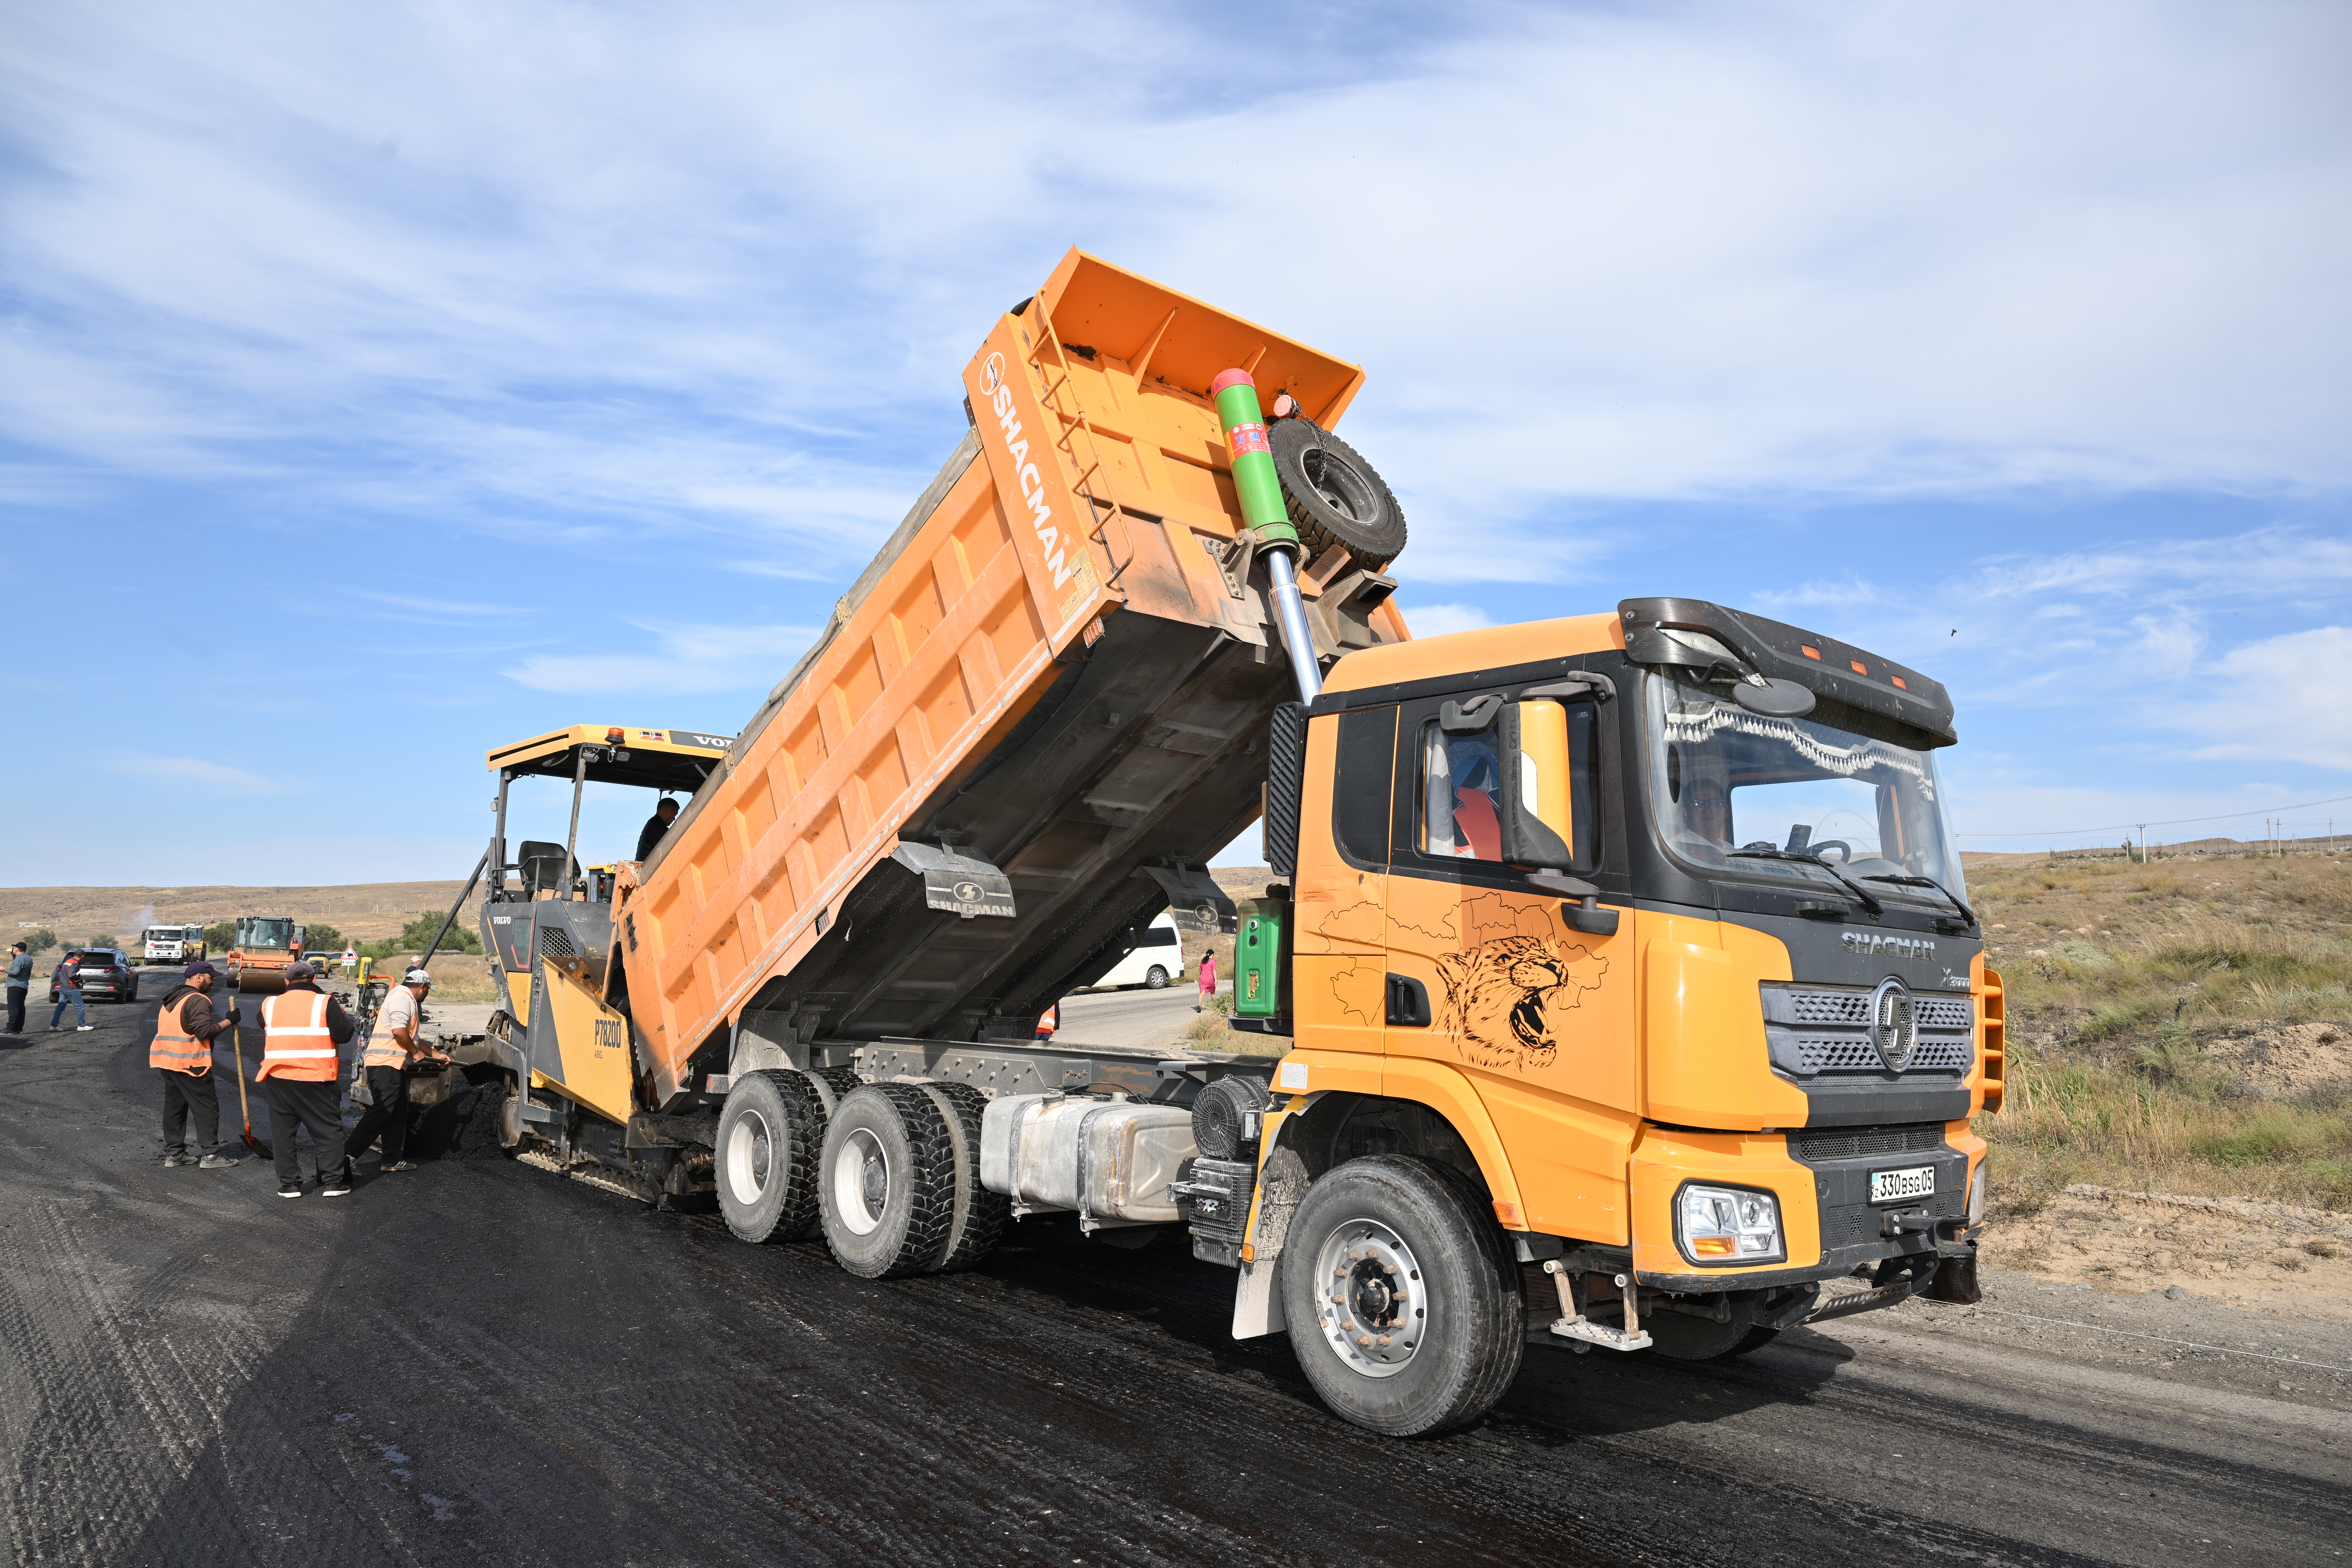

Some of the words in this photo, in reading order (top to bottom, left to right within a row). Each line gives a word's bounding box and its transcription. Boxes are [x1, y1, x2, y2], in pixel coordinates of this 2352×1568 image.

[1235, 432, 1260, 446] 万通
[993, 384, 1072, 591] SHACMAN
[928, 900, 1014, 916] SHACMAN
[1841, 932, 1936, 961] SHACMAN
[1939, 967, 1970, 989] X3000
[595, 1019, 621, 1048] P7820D
[594, 1050, 603, 1059] ABG
[1922, 1169, 1933, 1191] 05
